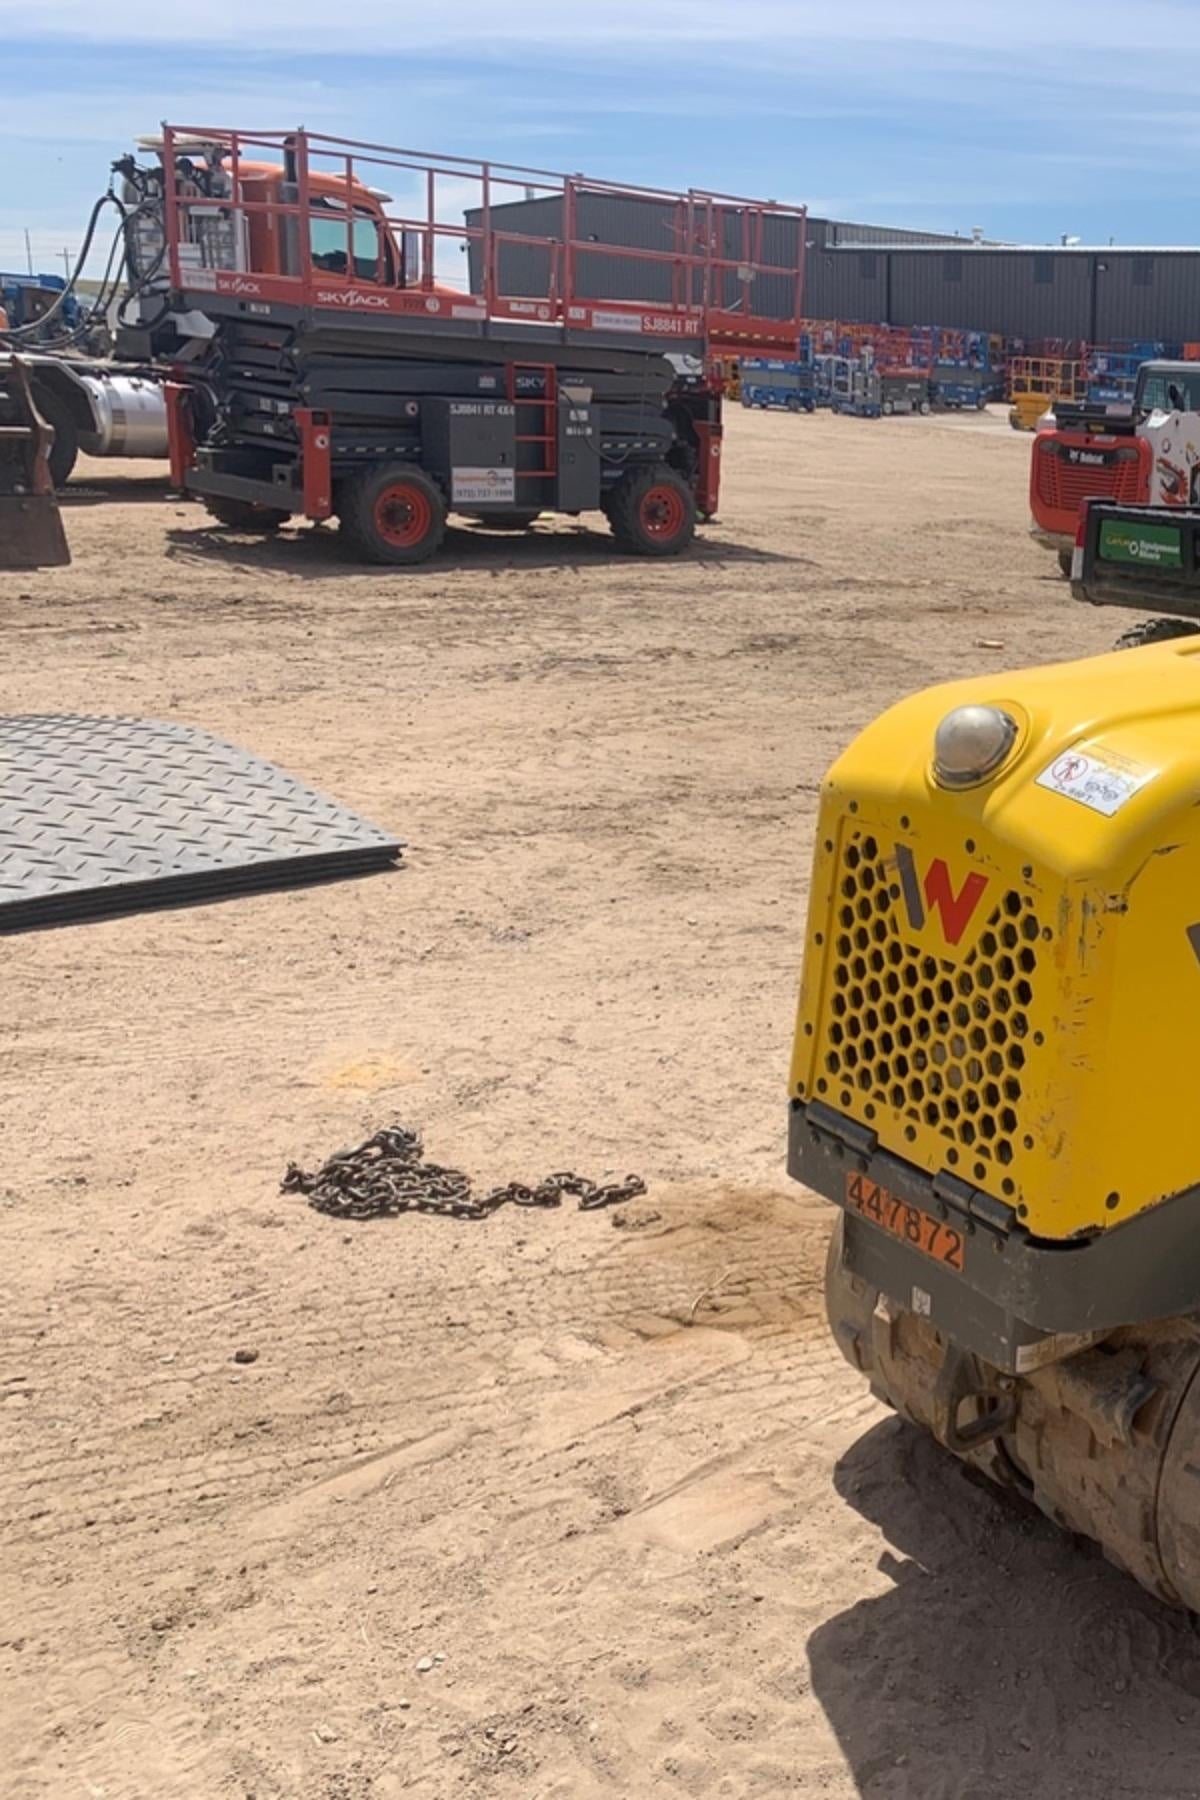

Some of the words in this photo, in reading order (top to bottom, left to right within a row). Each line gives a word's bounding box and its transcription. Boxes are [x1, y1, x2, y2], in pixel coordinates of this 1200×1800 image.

[217, 277, 261, 294] SKYJACK
[317, 290, 390, 308] SKYJACK
[685, 320, 699, 334] RT
[849, 1174, 961, 1269] 447872
